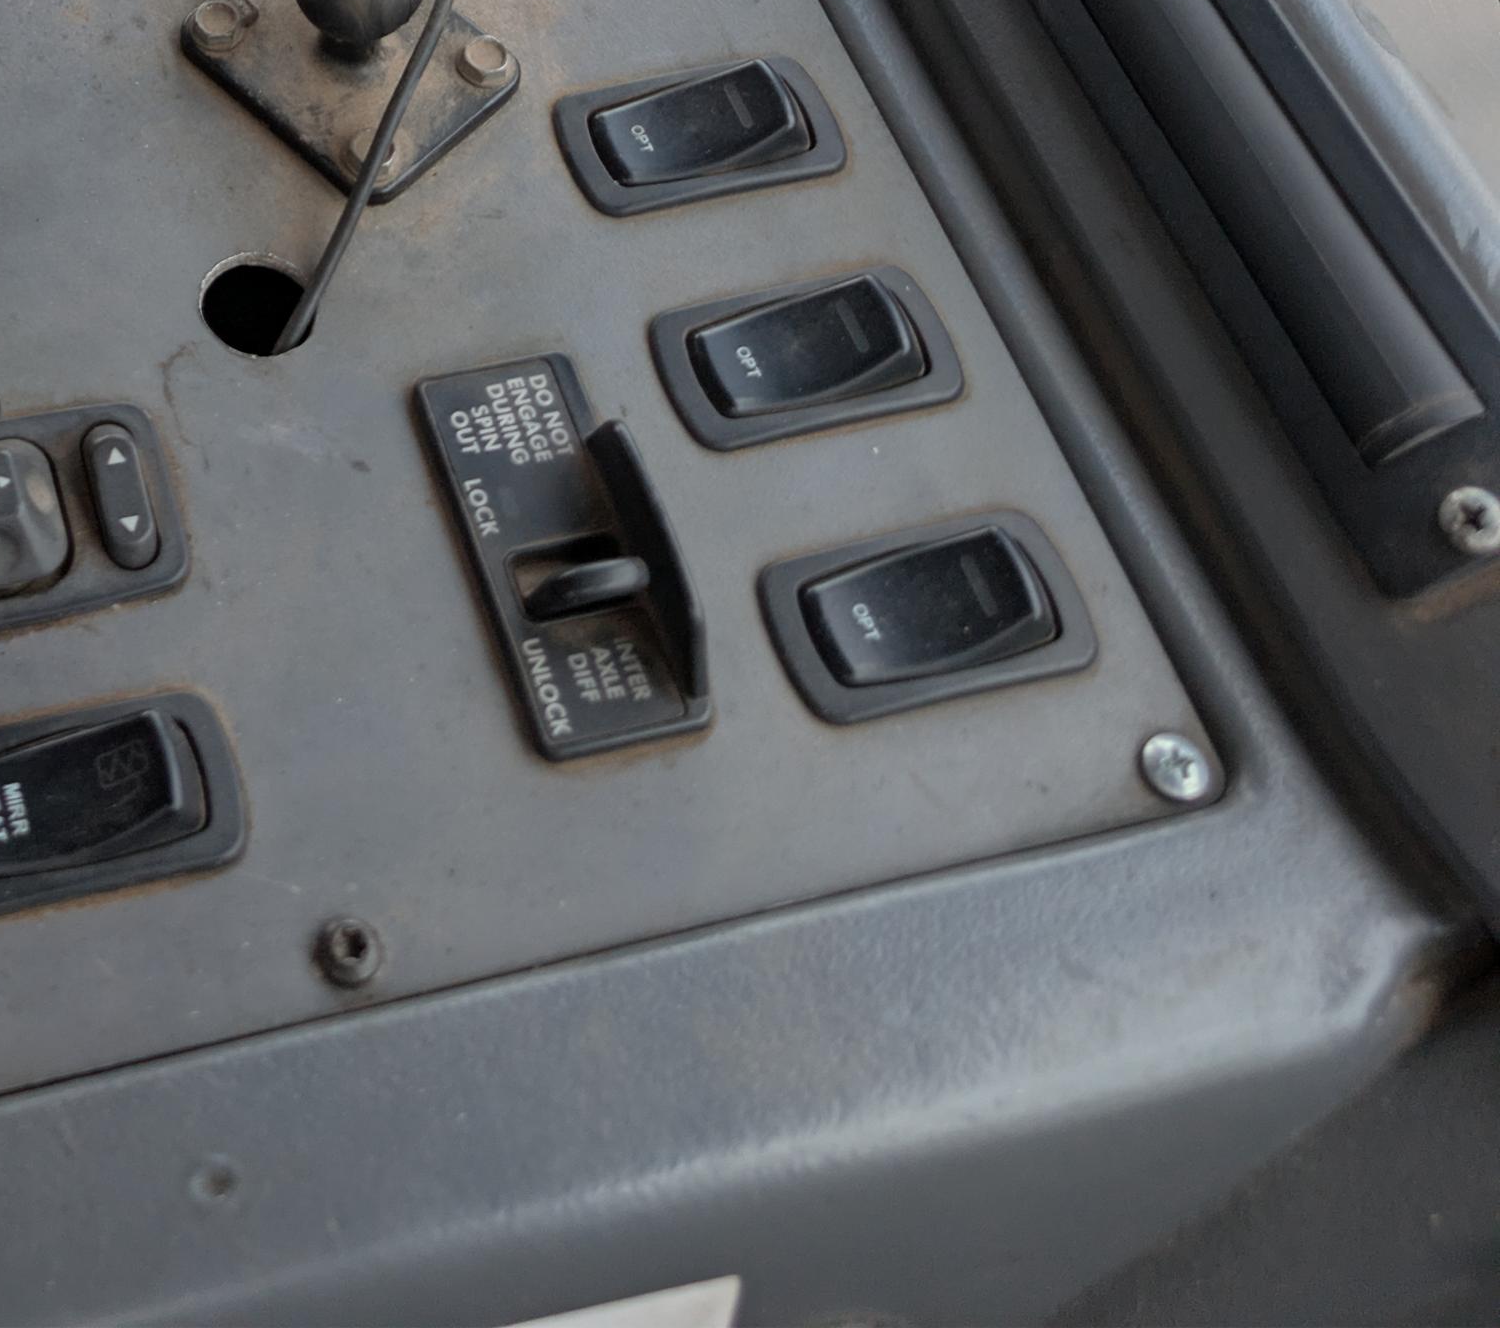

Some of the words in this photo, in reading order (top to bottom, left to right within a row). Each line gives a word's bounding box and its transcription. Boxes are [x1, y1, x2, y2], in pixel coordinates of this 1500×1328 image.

[631, 124, 654, 152] OPT
[736, 345, 763, 378] OPT
[450, 410, 481, 454] OUT
[471, 404, 502, 453] SPIN
[486, 383, 530, 465] DURING
[506, 376, 553, 463] ENGAGE
[528, 373, 554, 407] DO
[543, 410, 575, 456] NOT
[463, 477, 500, 537] LOCK
[852, 603, 880, 641] OPT
[522, 637, 573, 737] UNLOCK
[567, 652, 601, 702] DIFF
[590, 646, 626, 699] AXLE
[2, 782, 31, 837] MIRR
